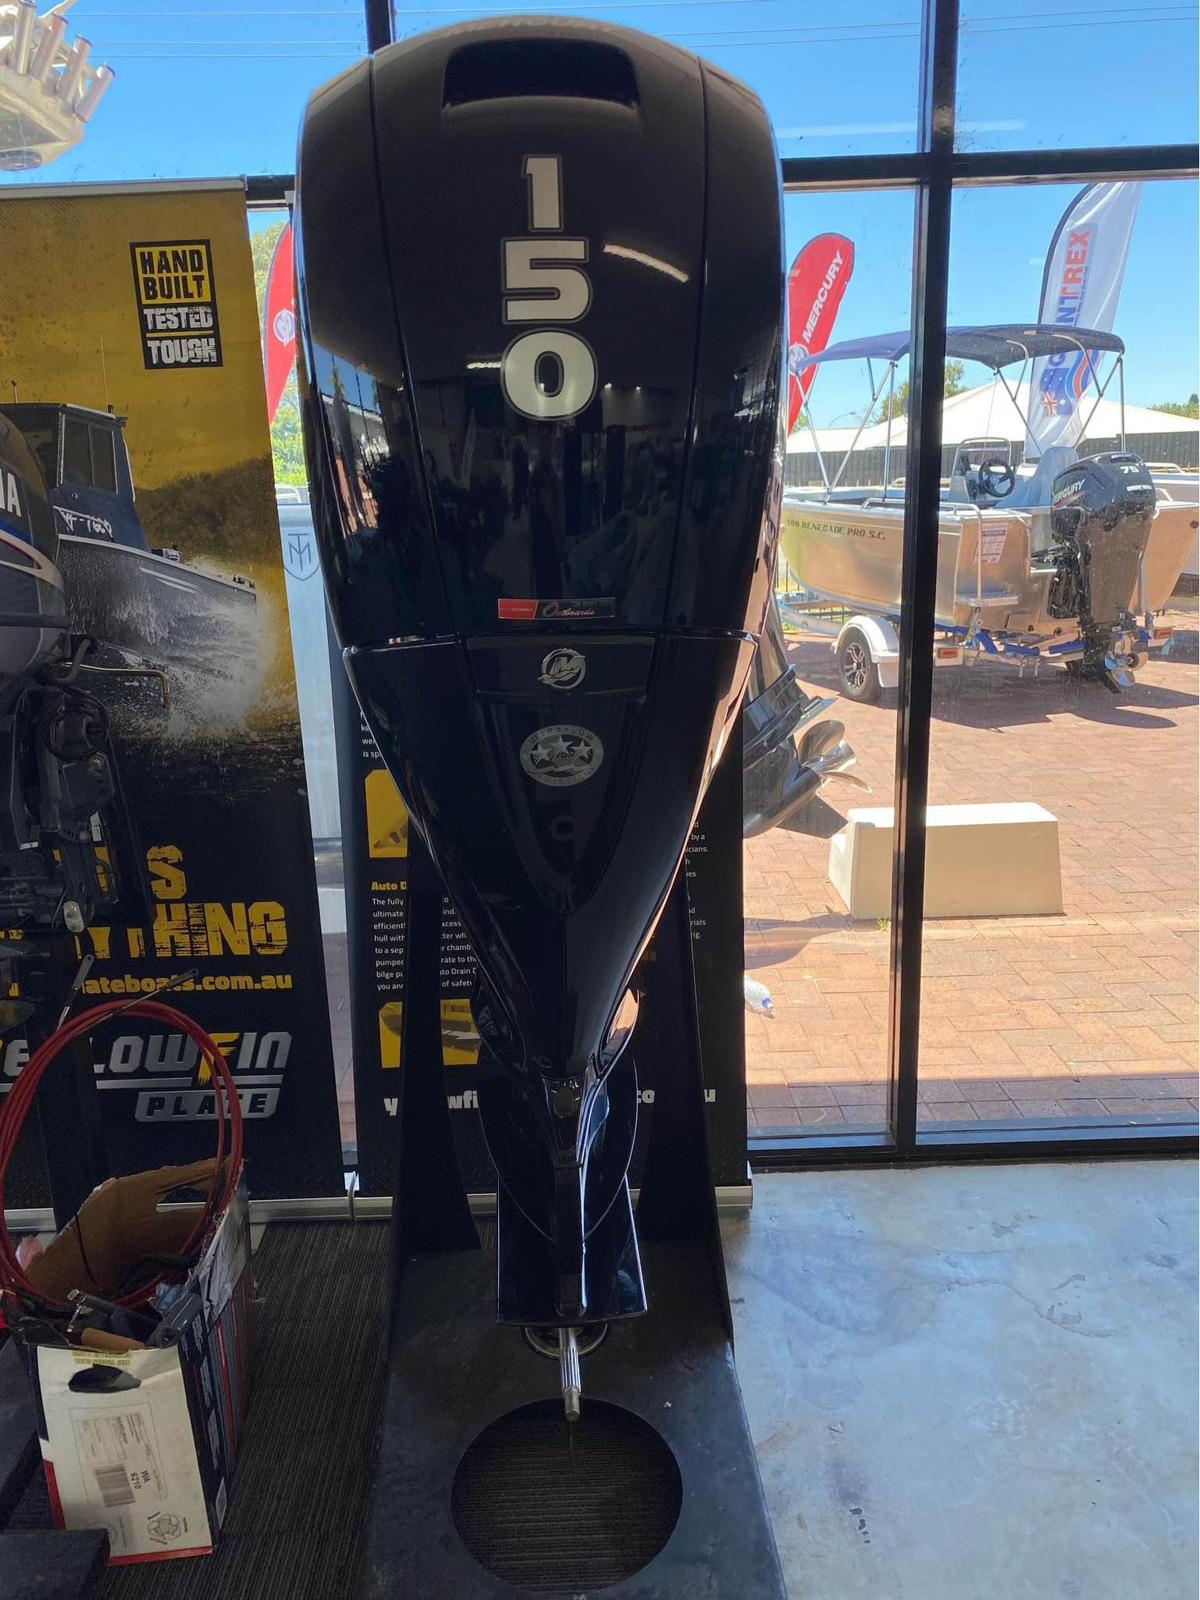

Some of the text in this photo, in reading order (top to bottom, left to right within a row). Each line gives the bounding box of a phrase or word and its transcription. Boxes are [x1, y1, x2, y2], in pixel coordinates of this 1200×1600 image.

[140, 249, 204, 275] HAND
[142, 274, 205, 300] BUILT
[500, 154, 599, 422] 150
[802, 250, 844, 343] MERCURY
[143, 306, 214, 330] TESTED
[147, 338, 217, 364] TOUGH
[1119, 465, 1140, 474] 75
[846, 526, 867, 539] PRO
[371, 880, 398, 891] Auto
[372, 897, 386, 906] The
[387, 897, 404, 907] fully
[372, 908, 457, 918] ultimate ind.
[373, 920, 462, 930] efficientl xcess
[375, 946, 383, 954] to
[390, 947, 404, 956] sep
[457, 955, 466, 963] to
[376, 970, 394, 980] bilge
[451, 967, 471, 975] Drain
[377, 982, 391, 992] you
[441, 979, 450, 987] of
